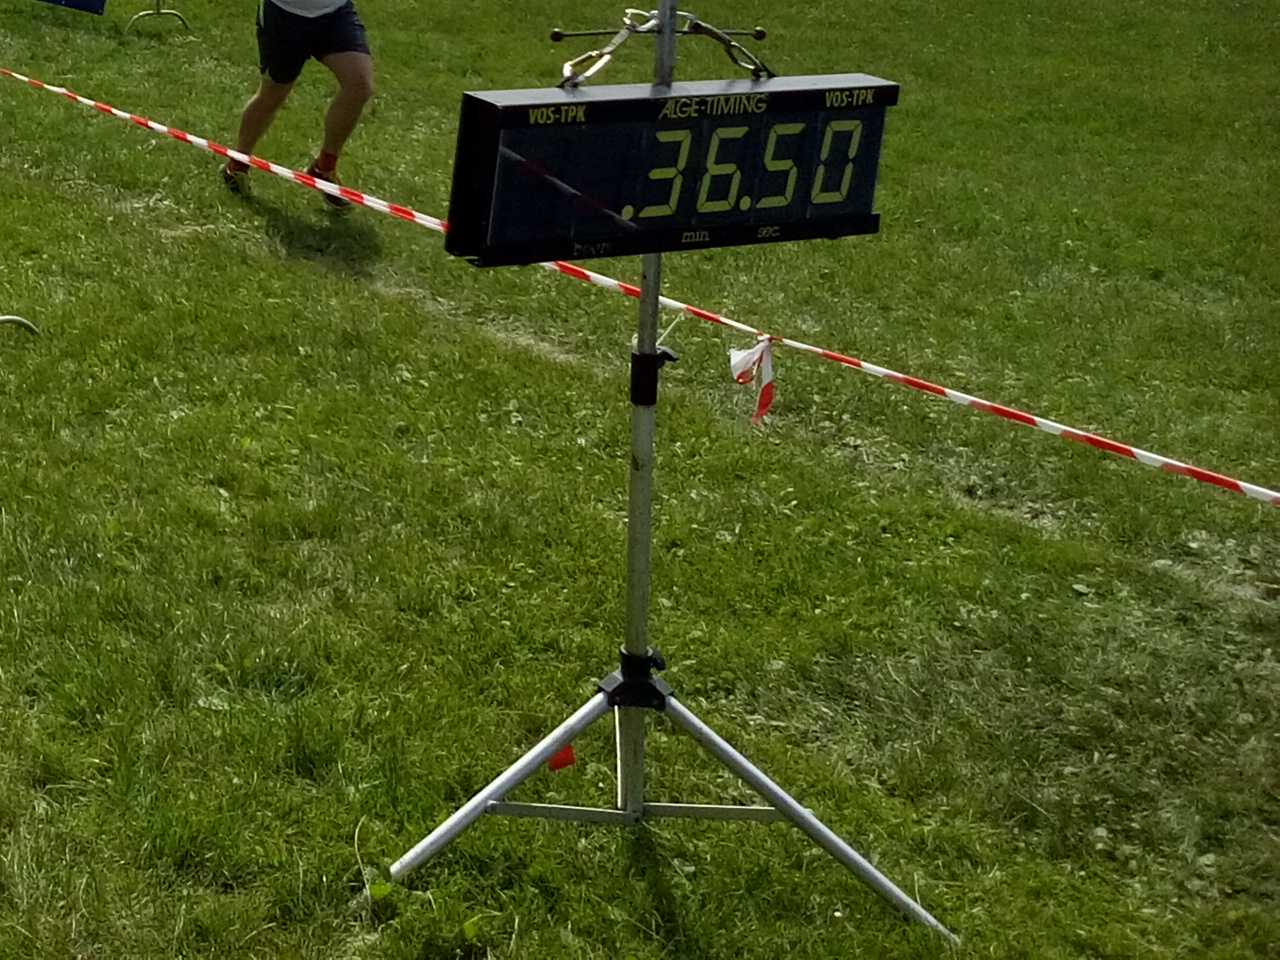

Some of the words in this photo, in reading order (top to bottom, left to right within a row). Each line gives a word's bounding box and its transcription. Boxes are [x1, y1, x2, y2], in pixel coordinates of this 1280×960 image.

[658, 93, 768, 119] ALGE-TIMING
[825, 89, 875, 108] VOS-TPK
[529, 105, 586, 125] VOS-TPK
